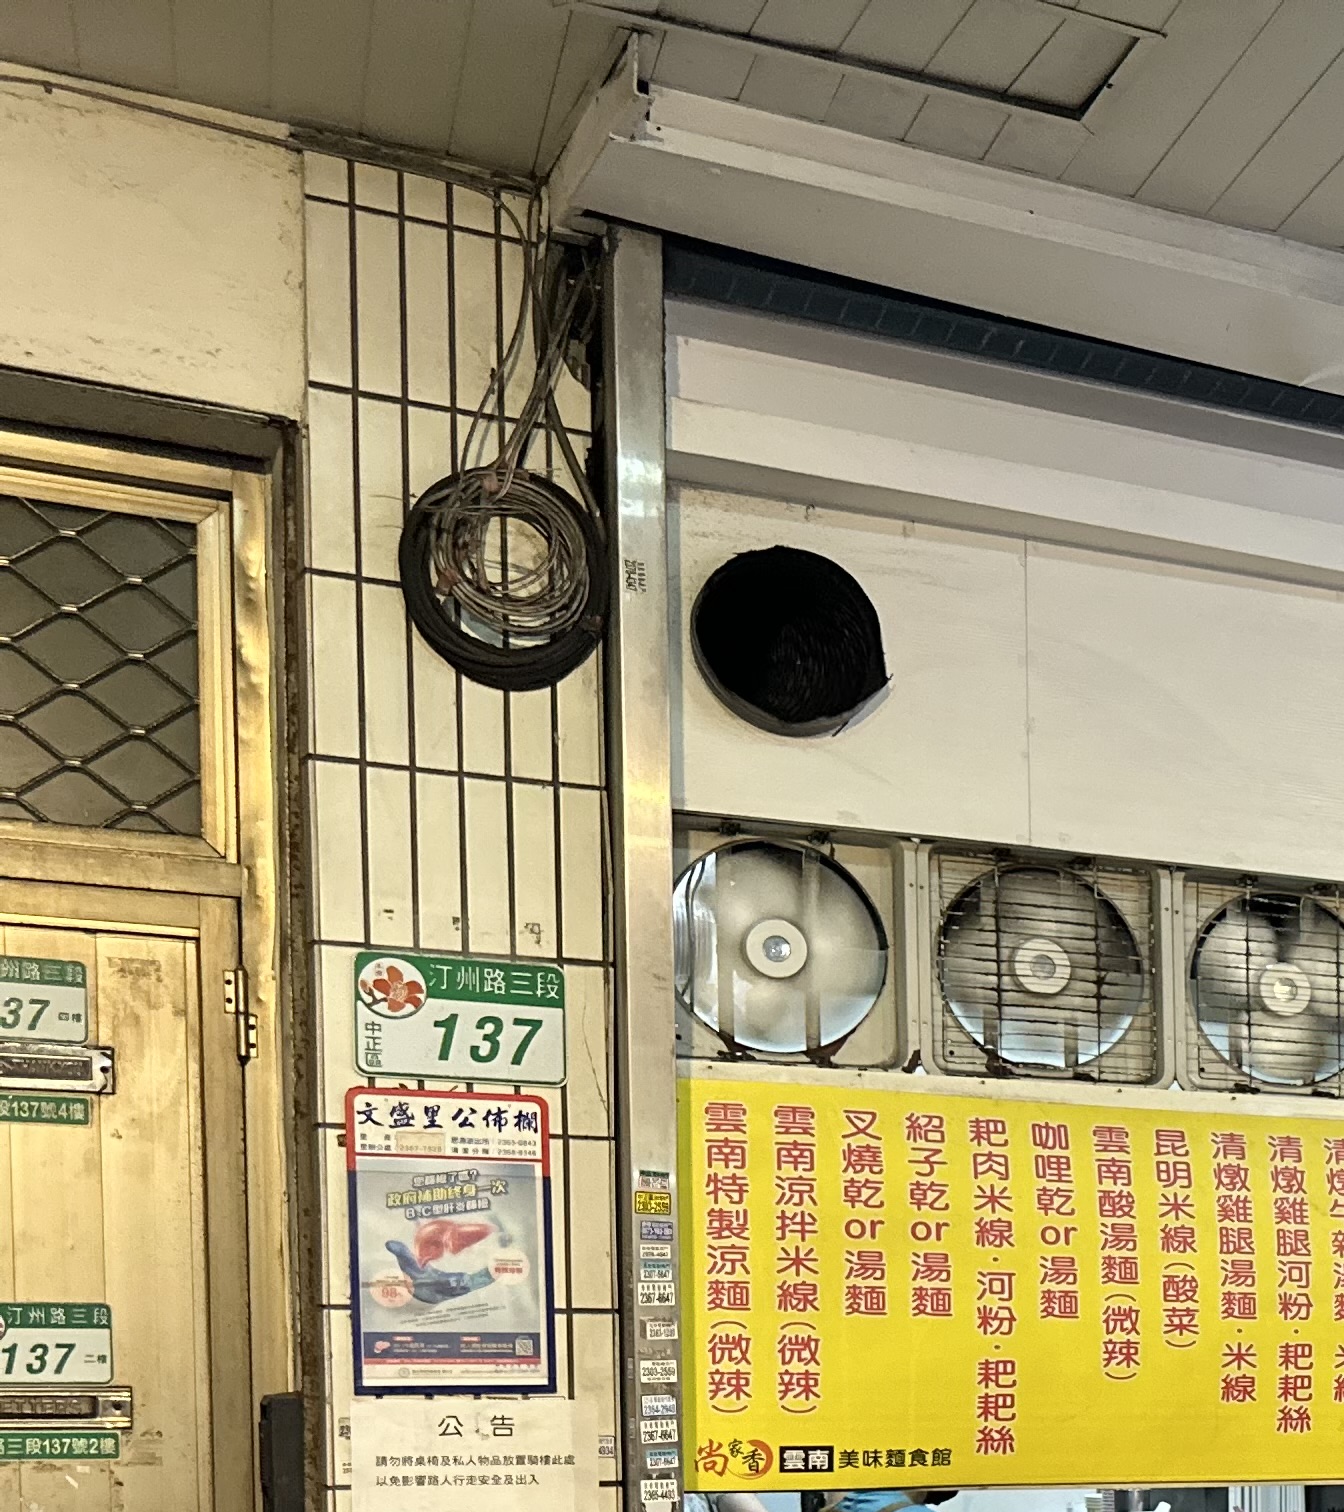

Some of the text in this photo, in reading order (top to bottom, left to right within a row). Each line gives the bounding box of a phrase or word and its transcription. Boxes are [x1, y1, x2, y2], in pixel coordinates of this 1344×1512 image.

[429, 964, 560, 999] 汀州路三段
[365, 1021, 382, 1067] 中正區
[433, 1013, 543, 1066] 137
[356, 1101, 538, 1134] 文盛里公佈欄
[1092, 1126, 1141, 1381] 雲南酸湯麵(微辣)
[1153, 1129, 1199, 1350] 昆明米線(酸菜)
[704, 1102, 752, 1414] 雲南特製涼麵(微辣)
[774, 1105, 822, 1414] 雲南涼拌米線(微辣)
[8, 1306, 109, 1326] 汀州路三段
[1, 1343, 76, 1375] 137
[438, 1415, 515, 1438] 公告
[0, 1438, 116, 1455] 三段137號2樓
[783, 1450, 829, 1470] 雲南
[838, 1448, 952, 1469] 美味麵食館
[375, 1474, 539, 1487] 以免影響路人行走安全及出入
